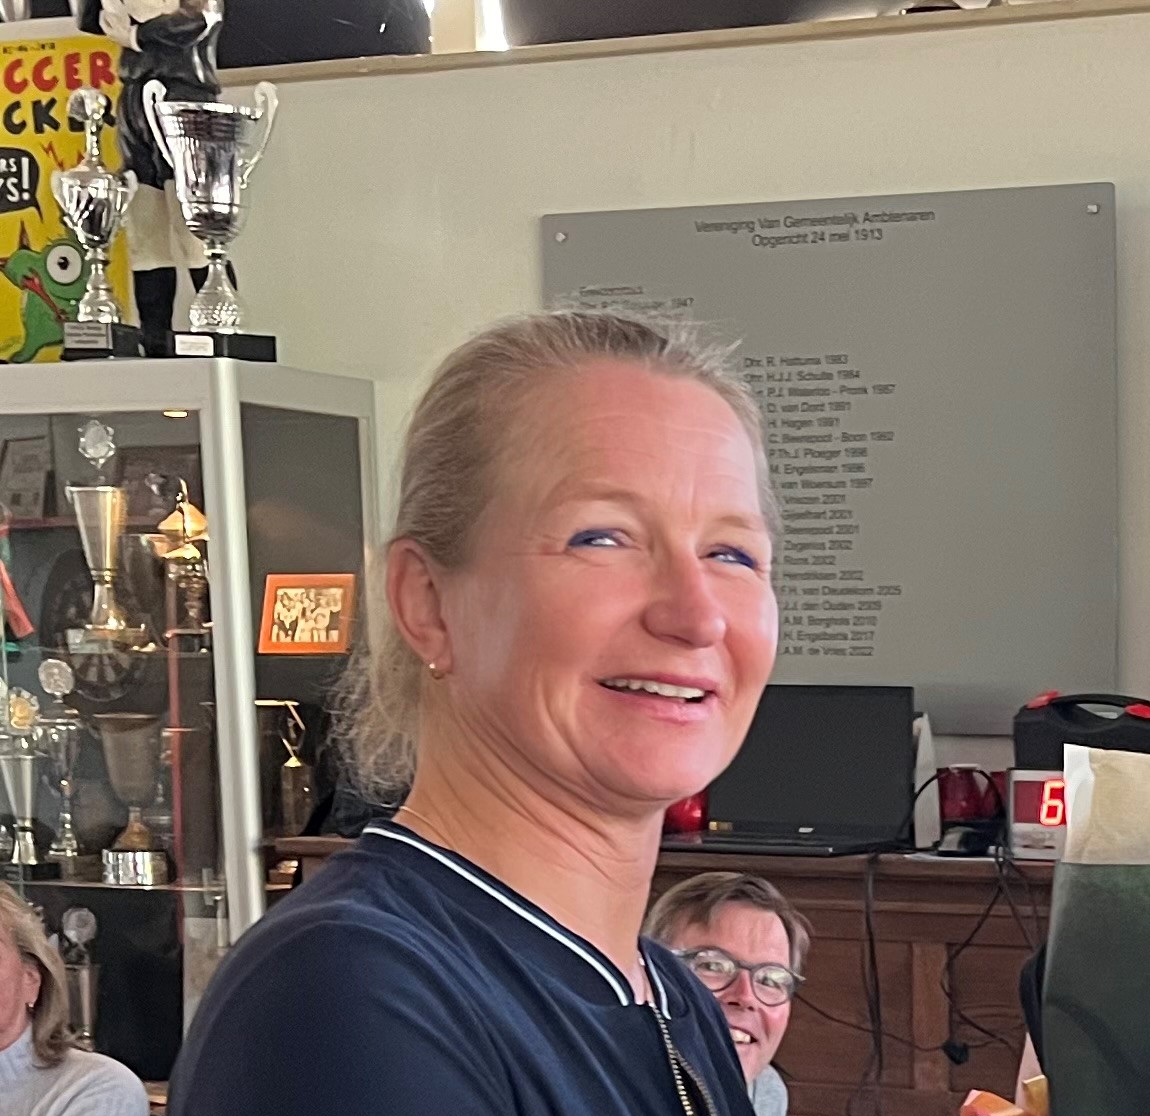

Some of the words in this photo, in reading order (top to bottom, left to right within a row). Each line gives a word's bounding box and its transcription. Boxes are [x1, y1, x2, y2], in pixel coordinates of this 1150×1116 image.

[3, 95, 116, 135] CK
[751, 231, 809, 248] Opgericht
[811, 230, 825, 243] 24
[828, 231, 850, 243] mei
[854, 228, 883, 241] 1913
[757, 217, 781, 229] Van
[1040, 779, 1065, 826] 6
